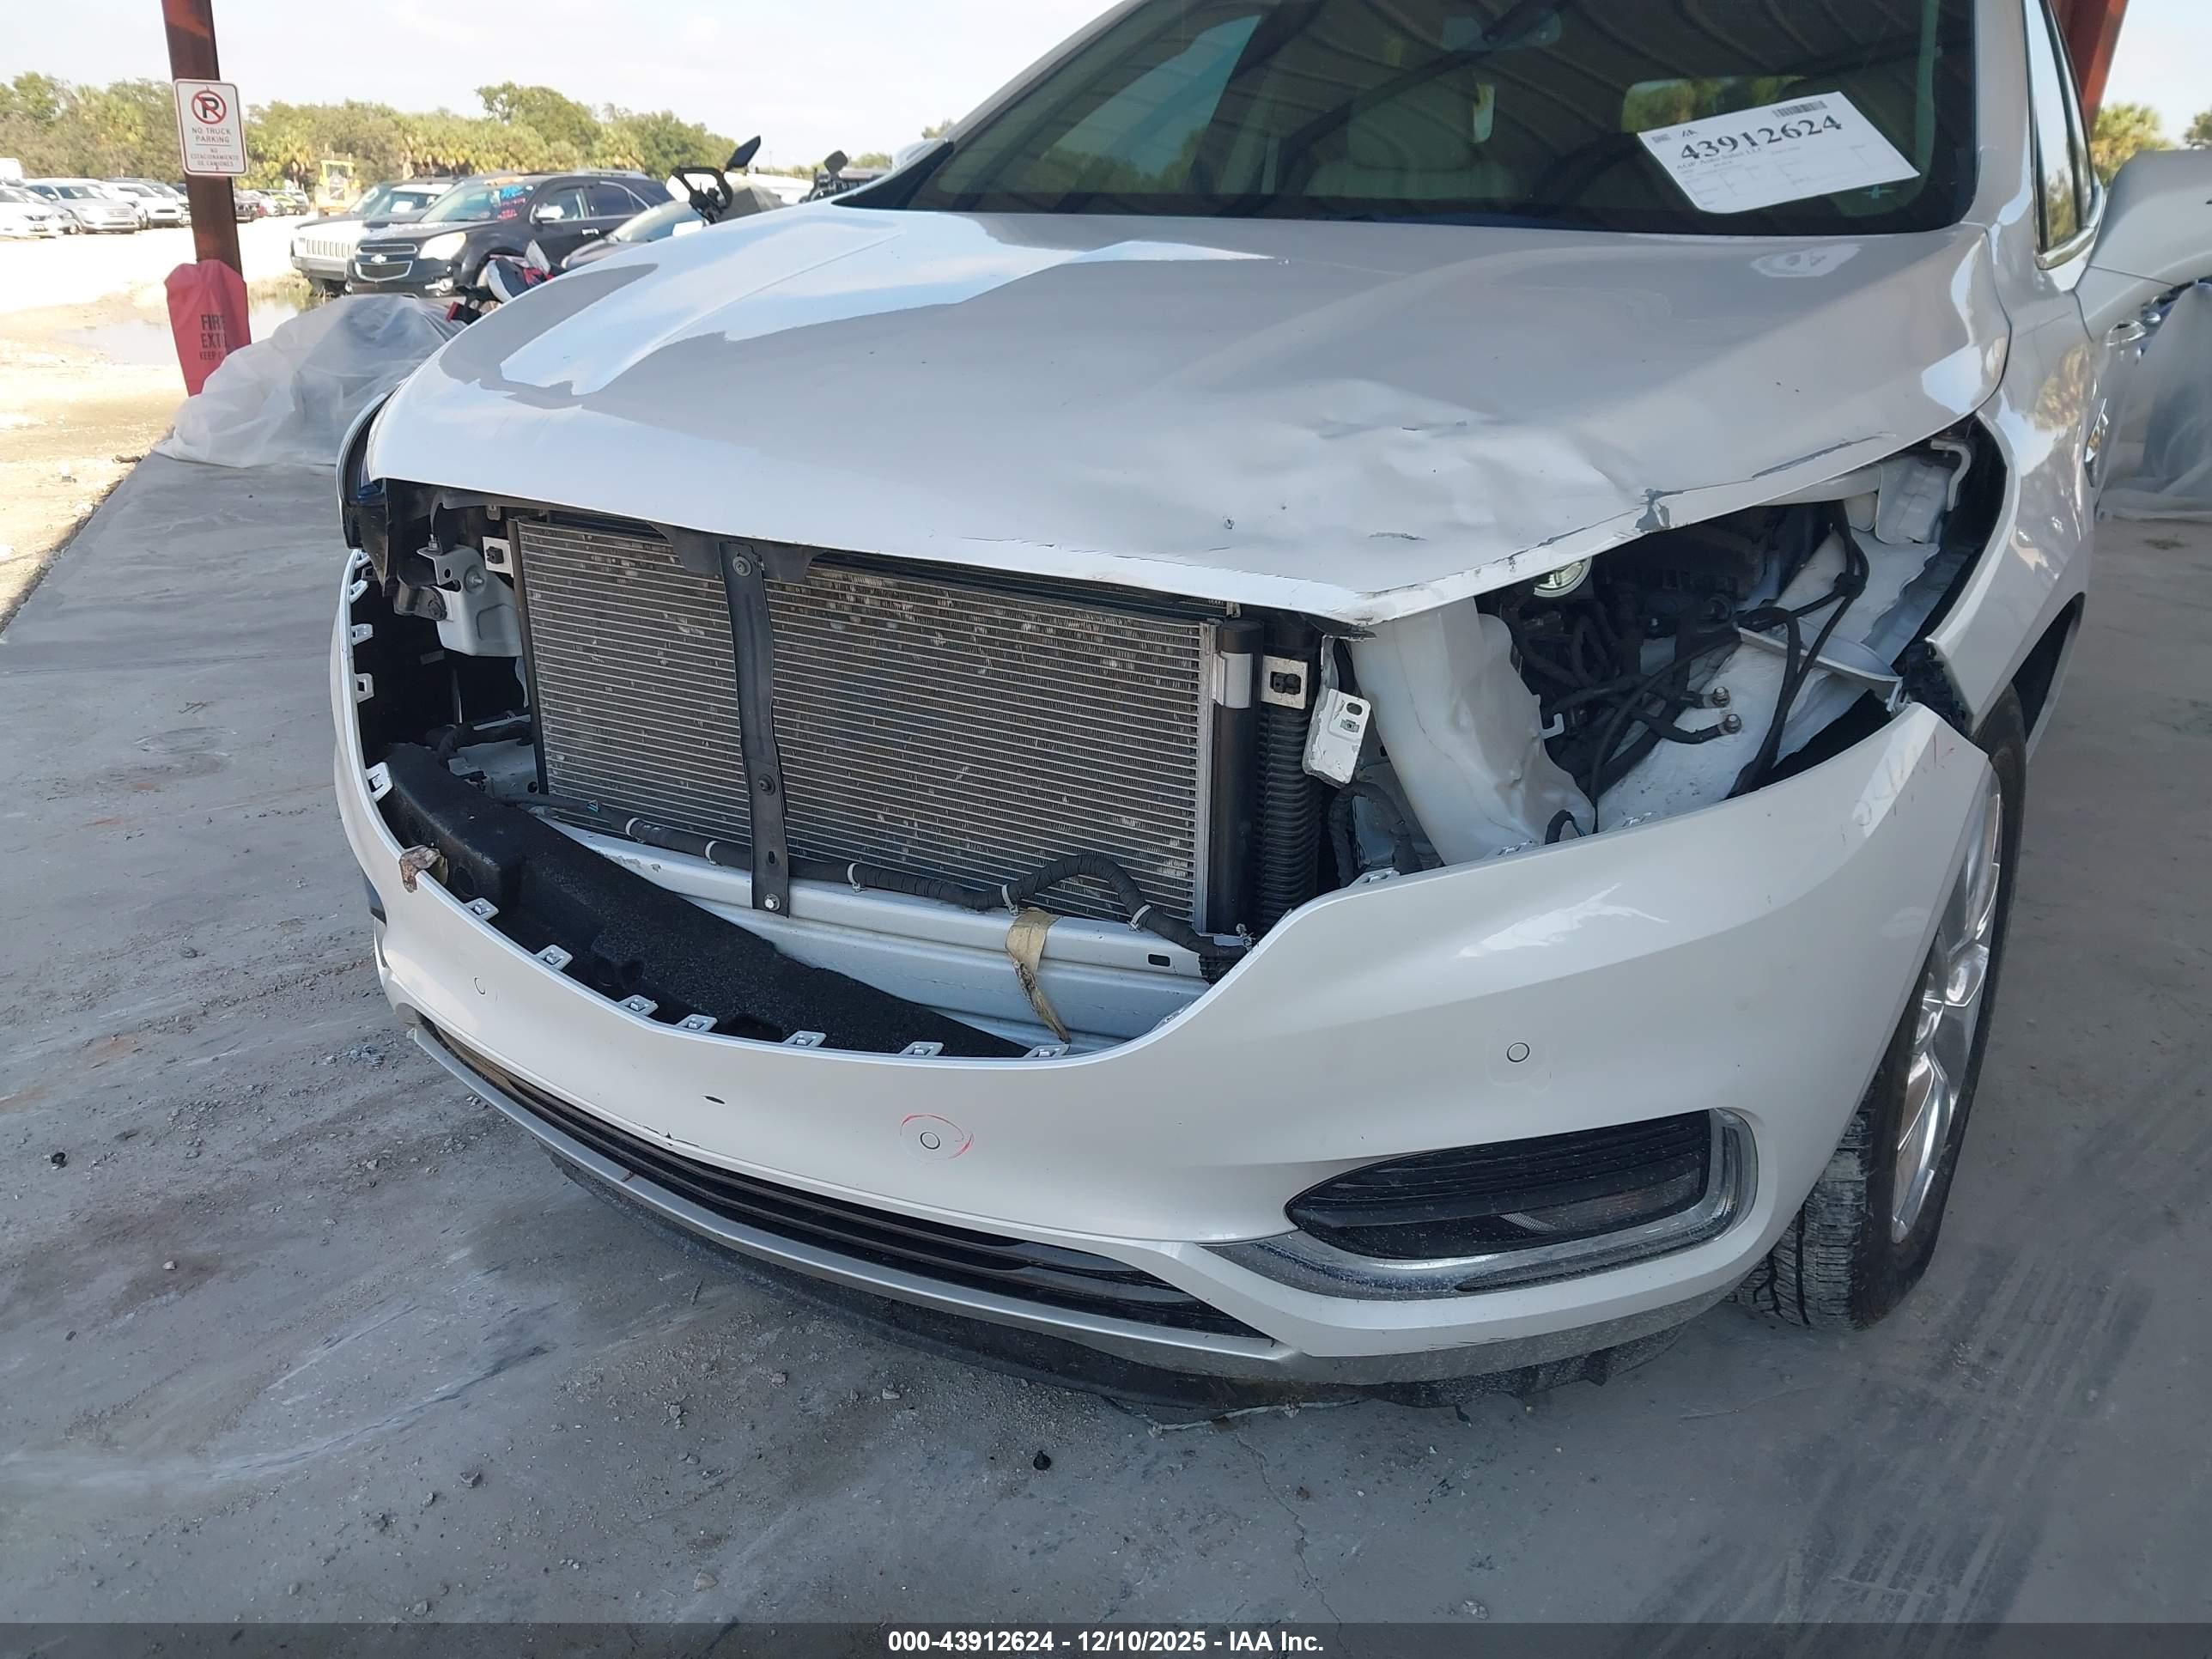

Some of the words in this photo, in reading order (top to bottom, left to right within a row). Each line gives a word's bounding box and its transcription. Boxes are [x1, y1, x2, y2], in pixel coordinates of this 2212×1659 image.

[206, 127, 231, 136] TRUCK
[195, 135, 229, 143] PARKING
[1680, 114, 1842, 160] 43912624
